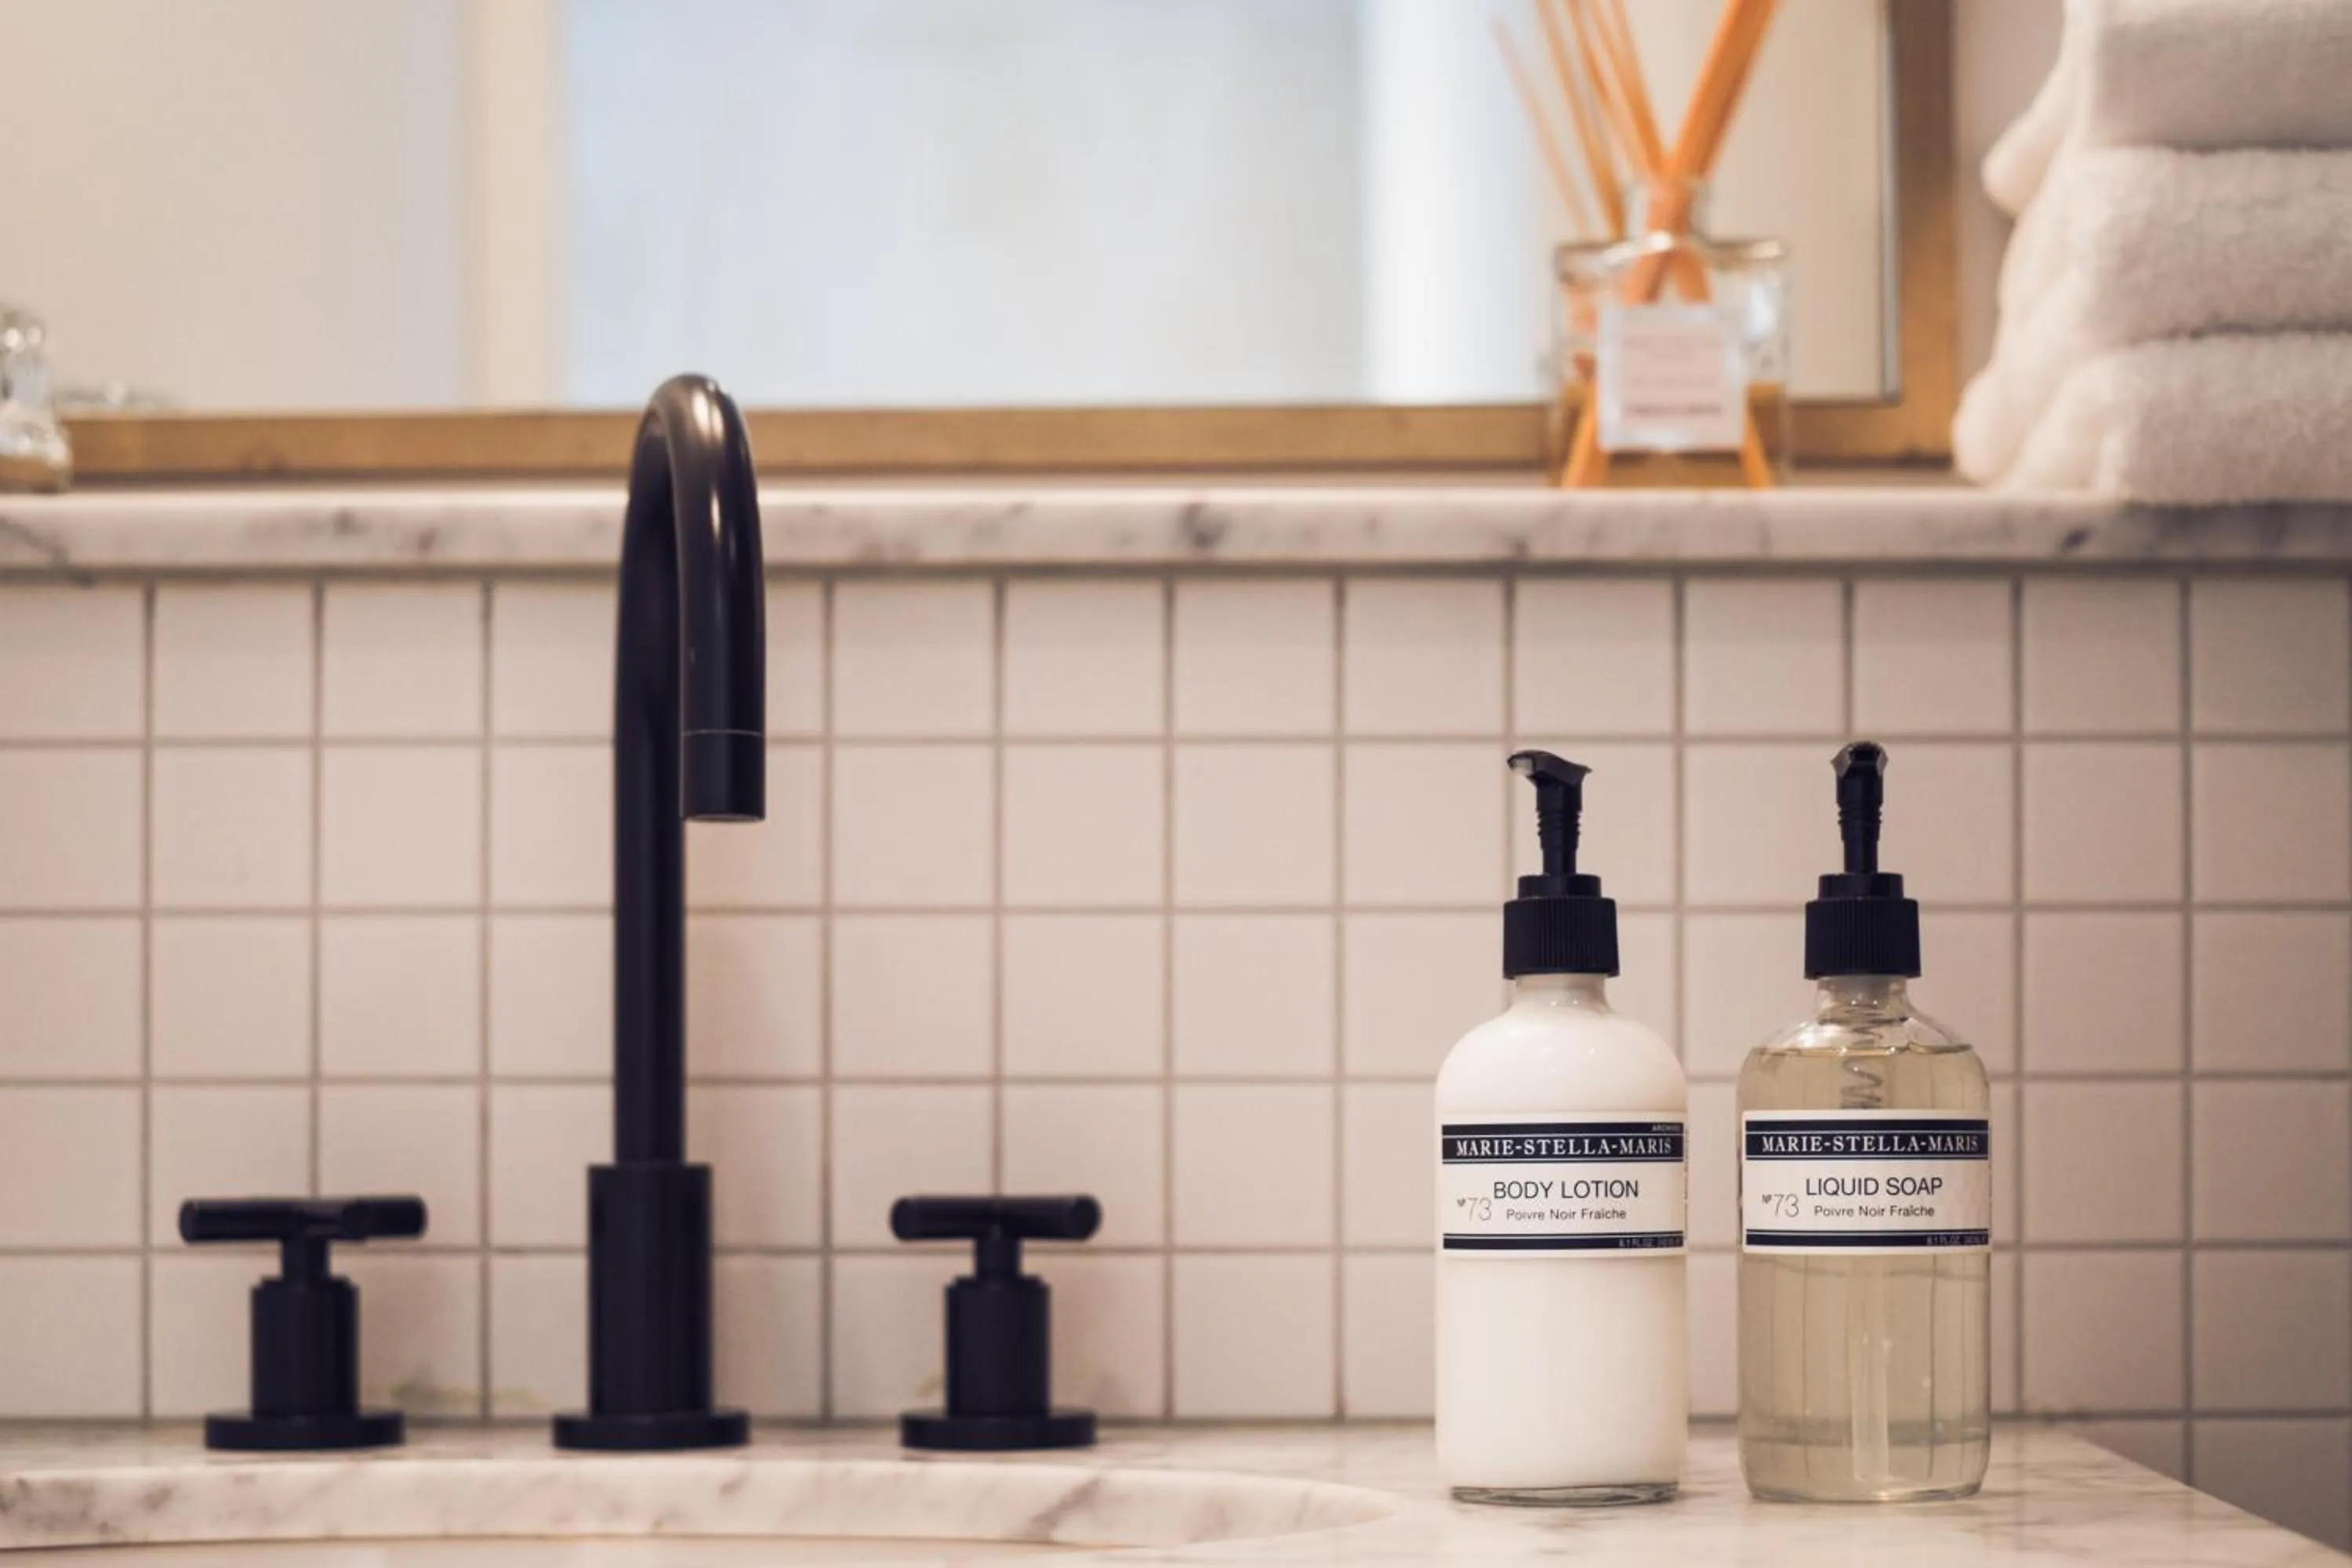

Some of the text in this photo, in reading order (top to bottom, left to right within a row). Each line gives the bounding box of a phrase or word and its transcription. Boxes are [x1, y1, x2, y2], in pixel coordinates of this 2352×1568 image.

[1457, 1138, 1671, 1156] MARIE-STELLA-MARIS
[1762, 1134, 1978, 1152] MARIE-STELLA-MARIS
[1494, 1180, 1639, 1199] BODY LOTION
[1806, 1177, 1943, 1196] LIQUID SOAP
[1506, 1208, 1545, 1221] Poivre
[1550, 1208, 1576, 1220] Noir
[1814, 1205, 1854, 1217] Poivre
[1859, 1205, 1885, 1217] Noir
